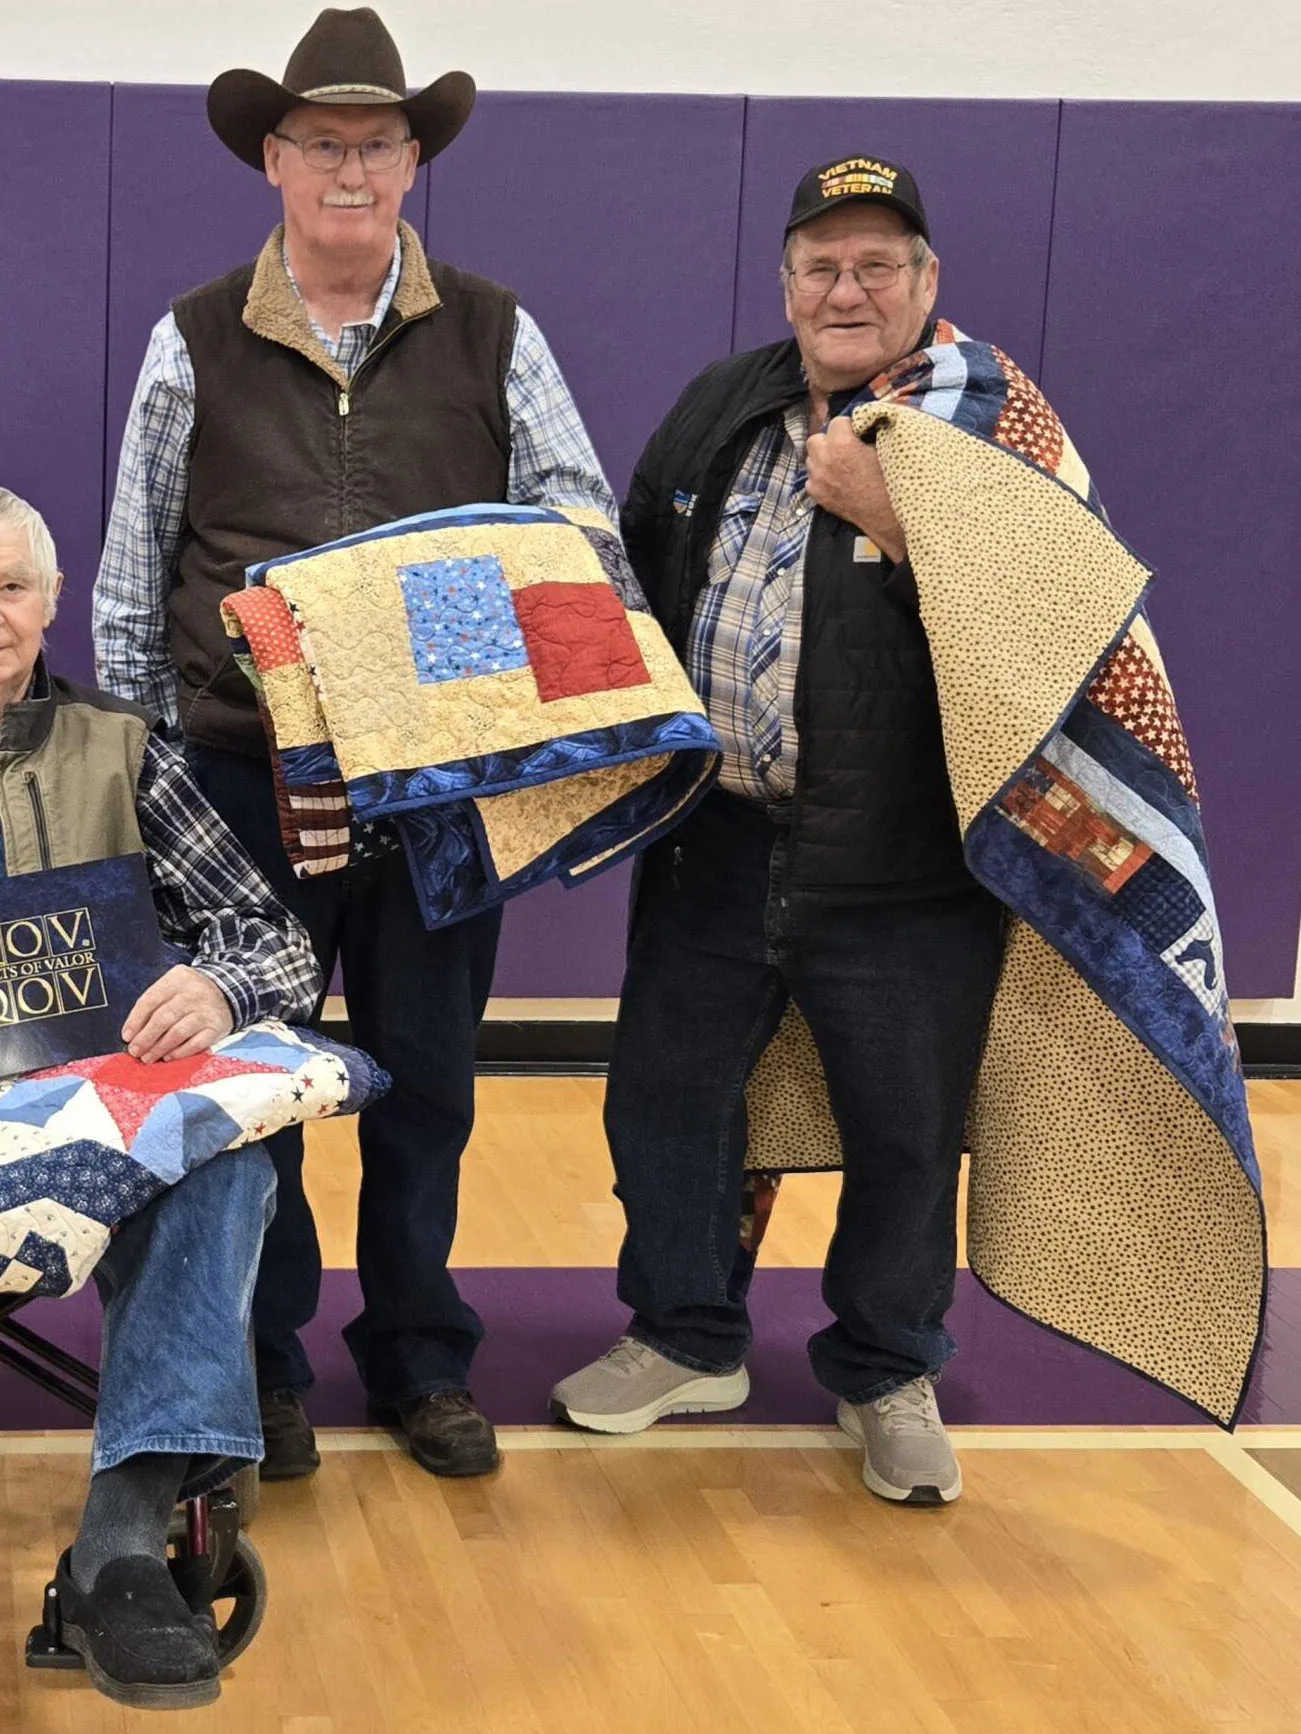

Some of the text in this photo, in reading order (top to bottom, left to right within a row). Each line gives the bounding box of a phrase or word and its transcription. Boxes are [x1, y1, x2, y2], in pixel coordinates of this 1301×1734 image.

[818, 158, 898, 181] VIETNAM
[821, 183, 893, 199] VETERAN
[21, 962, 42, 976] OF
[44, 952, 96, 971] VALOR
